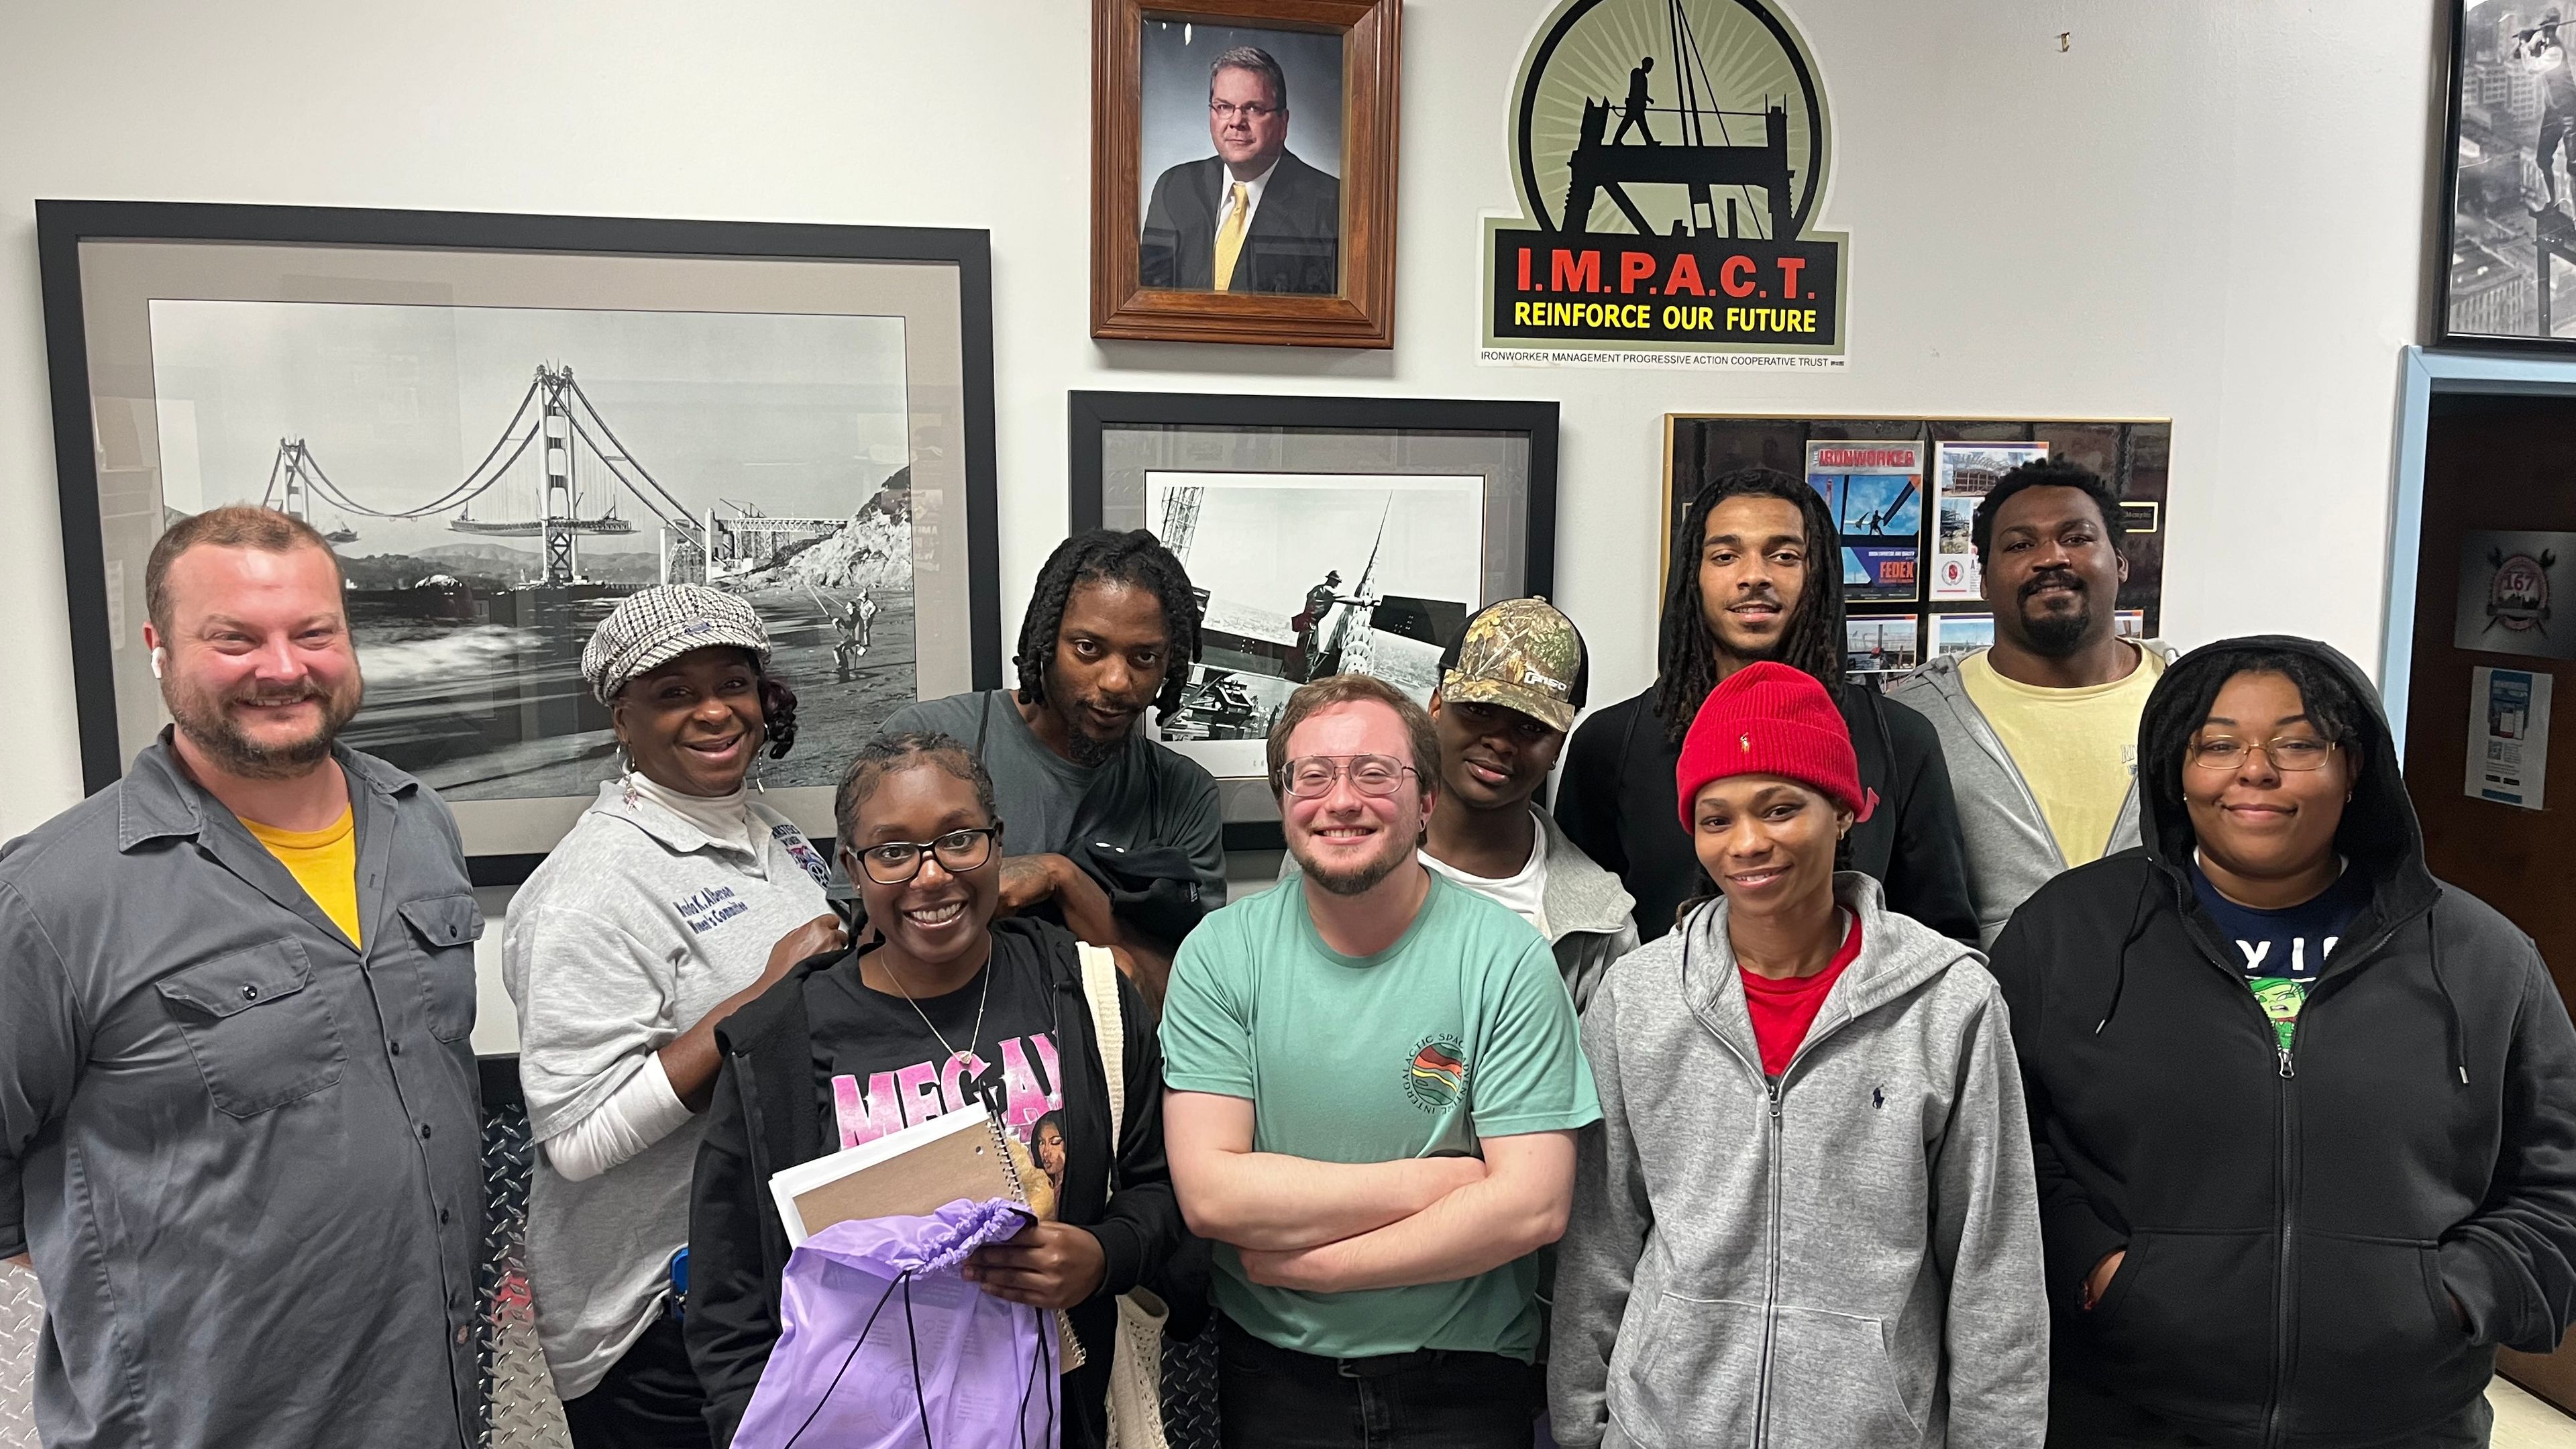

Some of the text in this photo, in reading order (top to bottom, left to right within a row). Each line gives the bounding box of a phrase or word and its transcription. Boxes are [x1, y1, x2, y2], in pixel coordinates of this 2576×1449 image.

[1517, 248, 1816, 301] I.M.P.A.C.T.
[1514, 301, 1817, 333] REINFORCE OUR FUTURE
[1481, 351, 1549, 362] IRONWORKER
[1552, 353, 1621, 363] MANAGEMENT
[1623, 354, 1691, 365] PROGRESSIVE
[1693, 356, 1728, 365] ACTION
[1731, 356, 1796, 366] COOPERATIVE
[1799, 358, 1829, 367] TRUST
[1819, 449, 1915, 467] IRONWORKER
[1880, 561, 1915, 578] FEDEX
[2503, 573, 2536, 592] 167
[1402, 1034, 1436, 1115] INTERGALACTIC
